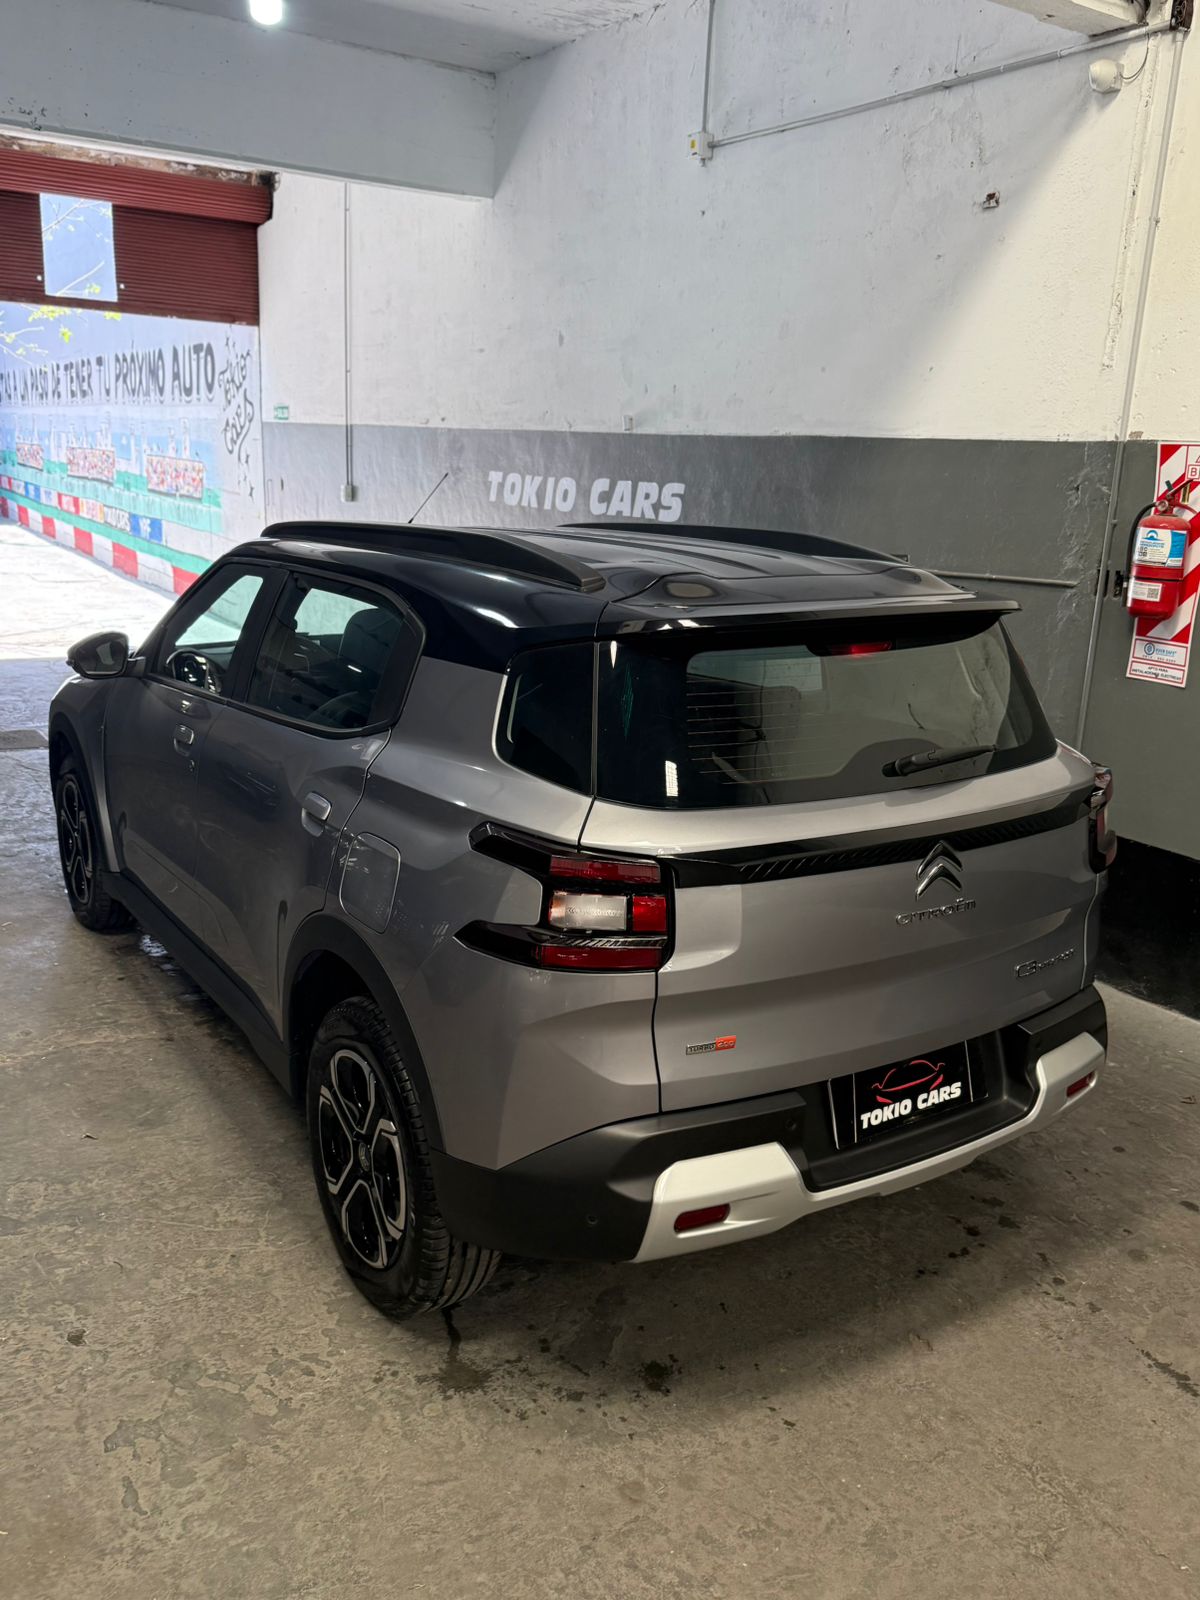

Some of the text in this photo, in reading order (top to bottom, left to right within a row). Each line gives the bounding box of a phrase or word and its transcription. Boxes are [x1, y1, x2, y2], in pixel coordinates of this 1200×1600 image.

[51, 361, 61, 399] DE
[63, 358, 93, 400] TENER
[96, 355, 110, 398] TU
[115, 340, 165, 398] PRÓXIMO
[172, 342, 216, 398] AUTO
[1190, 466, 1198, 477] B
[488, 471, 685, 522] TOKIO CARS
[860, 1081, 962, 1129] TOKIO CARS
